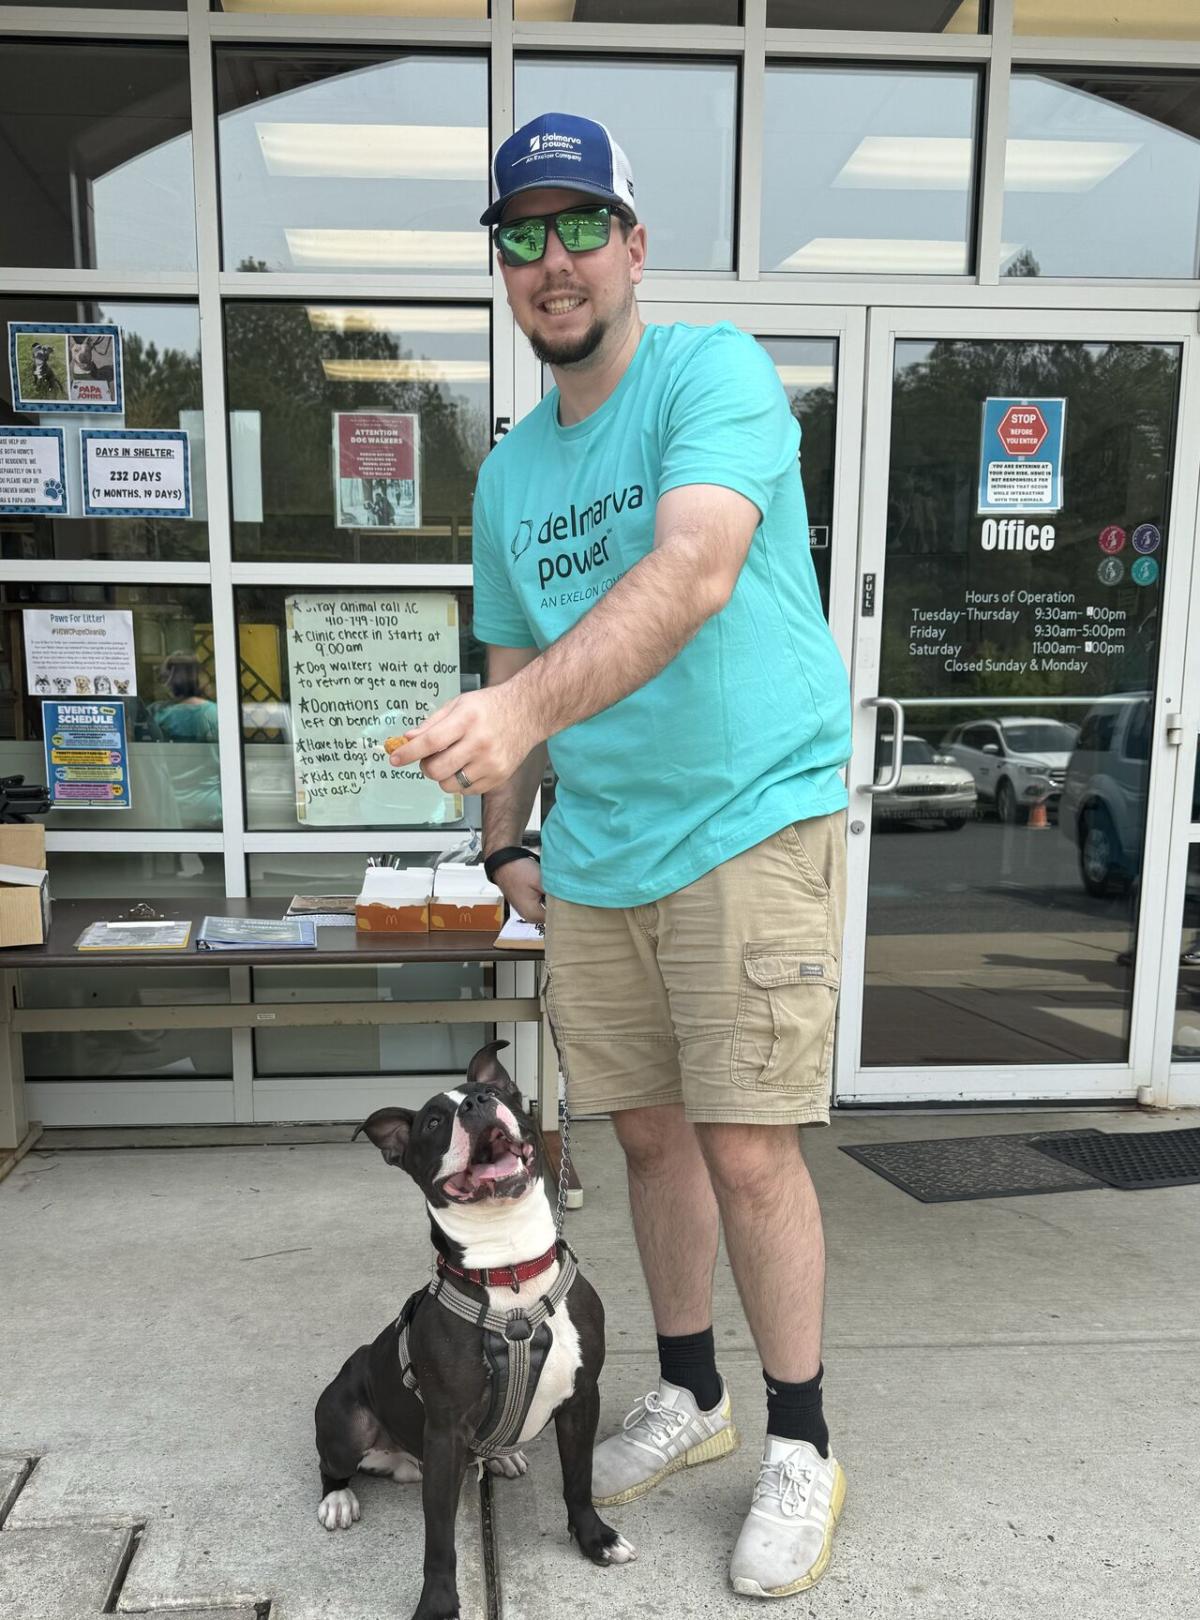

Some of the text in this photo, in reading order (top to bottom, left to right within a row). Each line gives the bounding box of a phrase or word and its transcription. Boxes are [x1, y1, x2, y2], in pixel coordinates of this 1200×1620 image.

[542, 133, 582, 144] delmarva
[542, 140, 570, 150] power
[1011, 414, 1036, 424] STOP
[96, 448, 175, 457] DAYS IN SHELTER:
[110, 472, 161, 482] 232 DAYS
[92, 489, 181, 500] (7 MONTHS, 19 DAYS)
[537, 484, 644, 544] delmarva
[980, 519, 1056, 551] Office
[538, 535, 610, 590] power
[540, 596, 557, 608] AN
[561, 583, 599, 606] EXELON
[965, 591, 1075, 606] Hours of Operation
[340, 601, 376, 613] animal
[381, 602, 400, 613] call
[50, 614, 106, 624] Paws For Litter!
[326, 616, 398, 626] 410-749-1070
[912, 608, 1020, 623] Tuesday-Thursday
[306, 630, 335, 642] Clinic
[338, 629, 369, 640] check
[372, 629, 382, 640] in
[428, 631, 441, 641] at
[910, 625, 1126, 641] Friday 9:30am-5:00pm
[909, 643, 962, 659] Saturday
[306, 661, 457, 677] Dog walkers wait at door
[944, 660, 1088, 674] Closed Sunday & Monday
[298, 677, 312, 689] to
[316, 676, 351, 688] return
[354, 677, 364, 685] or
[367, 677, 385, 690] get
[399, 678, 417, 687] new
[420, 679, 439, 697] dog
[58, 706, 98, 714] EVENTS
[311, 699, 429, 713] Donations can be
[58, 716, 113, 724] SCHEDULE
[301, 718, 324, 729] left
[329, 717, 343, 726] on
[347, 714, 381, 726] bench
[385, 716, 396, 725] or
[307, 739, 332, 751] Have
[334, 738, 344, 749] to
[346, 739, 358, 749] be
[300, 753, 314, 765] to
[344, 751, 367, 765] dogs
[372, 752, 385, 761] or
[311, 772, 334, 784] Kids
[338, 769, 357, 780] can
[360, 768, 376, 784] get
[381, 770, 387, 778] a
[306, 785, 350, 804] just ask
